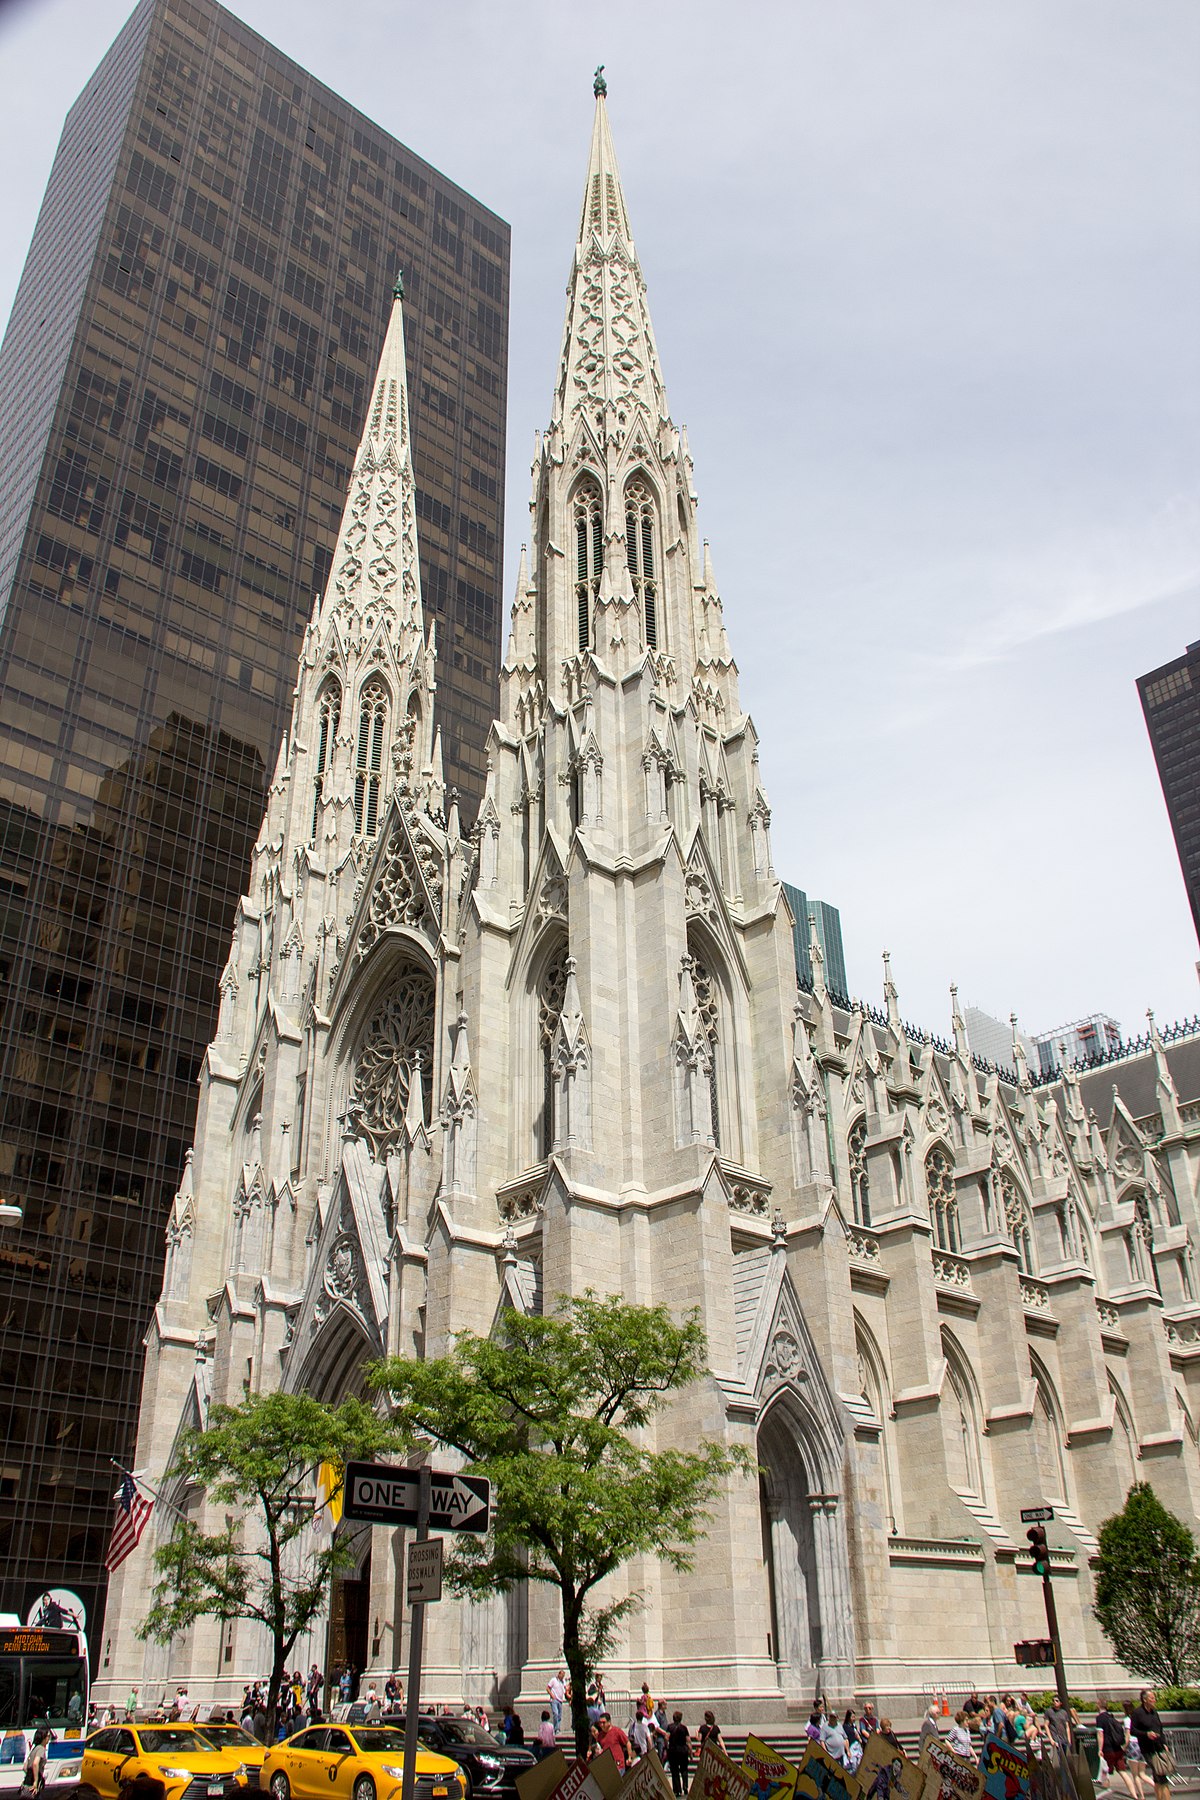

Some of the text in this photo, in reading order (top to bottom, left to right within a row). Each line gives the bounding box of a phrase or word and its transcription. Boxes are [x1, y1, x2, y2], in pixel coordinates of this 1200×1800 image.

[358, 1481, 474, 1514] ONE WAY
[410, 1548, 439, 1564] CROSSING
[14, 1635, 43, 1643] MIDTOWN
[4, 1643, 49, 1651] PENN STATION
